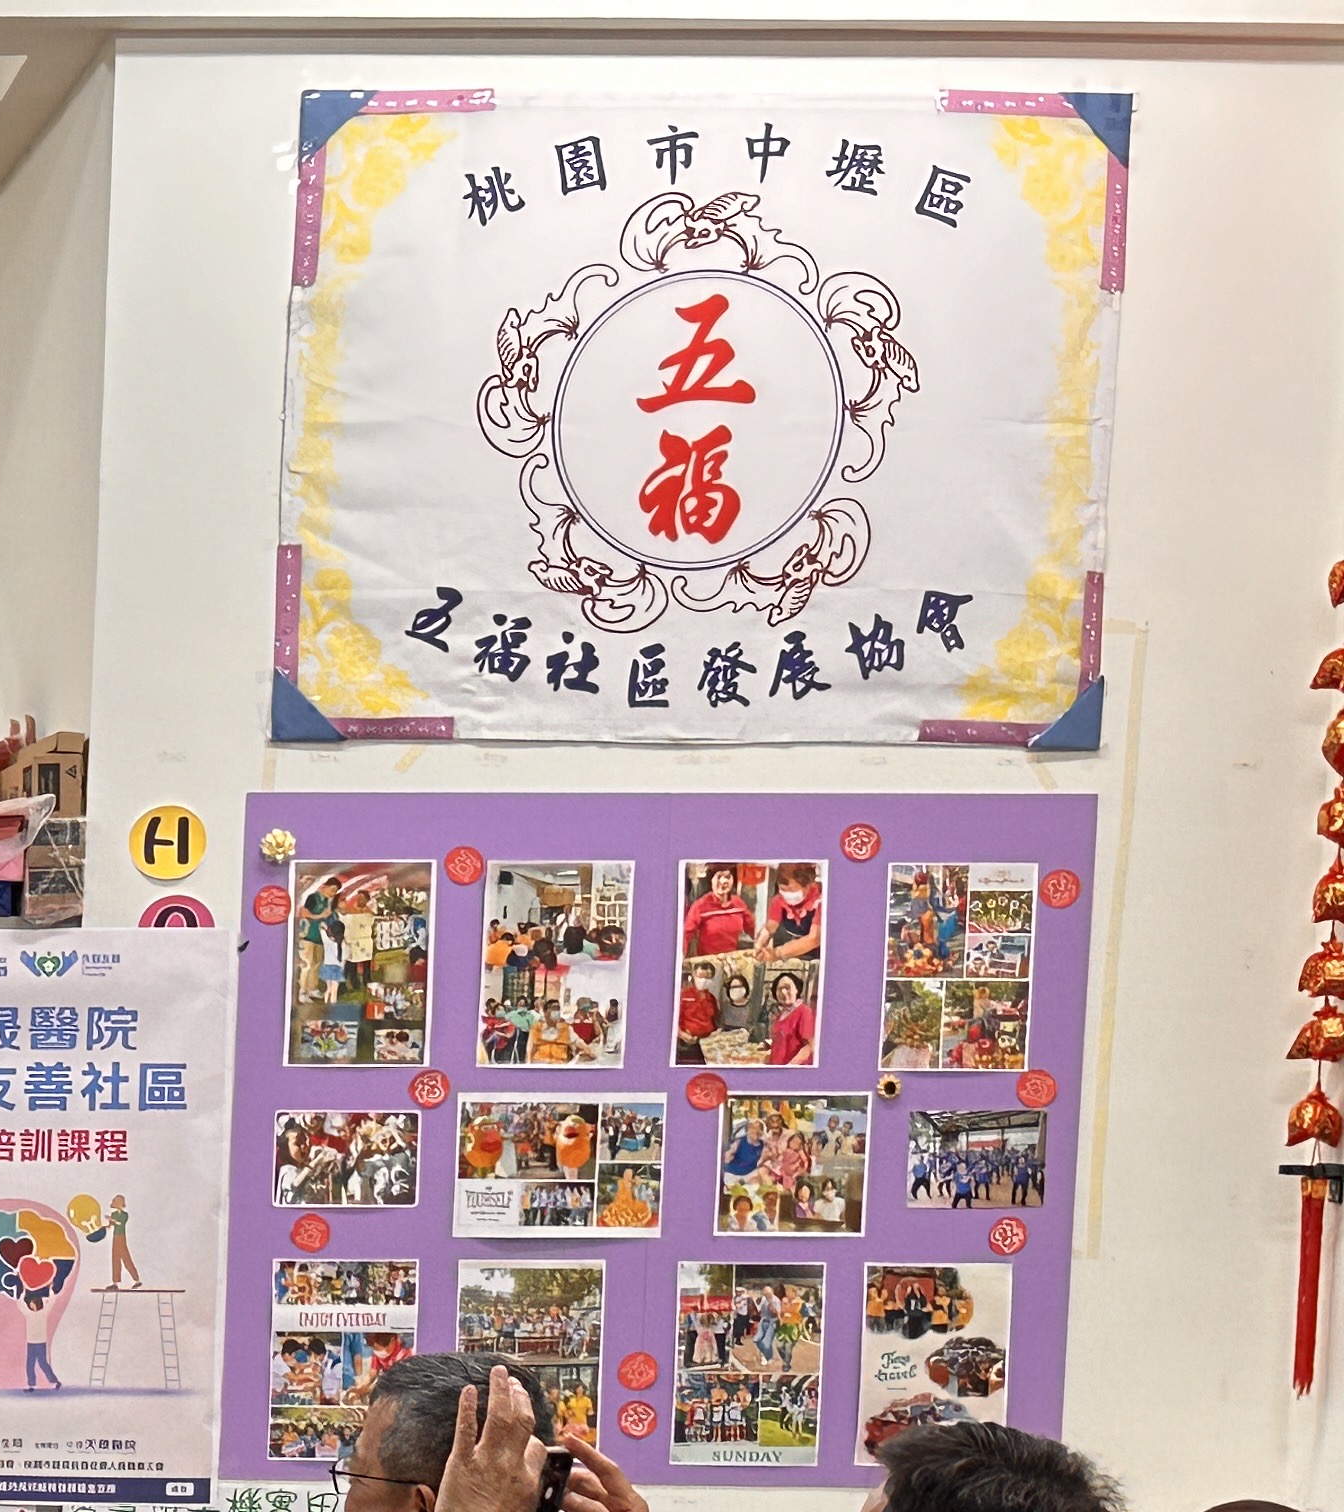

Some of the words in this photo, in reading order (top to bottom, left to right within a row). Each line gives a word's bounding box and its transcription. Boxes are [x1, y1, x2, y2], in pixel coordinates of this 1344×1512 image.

[463, 123, 972, 228] 桃園市中壢區
[636, 294, 757, 544] 五福
[406, 587, 974, 709] 五福社區發展協會
[144, 816, 190, 865] H
[711, 1450, 783, 1464] SUNDAY
